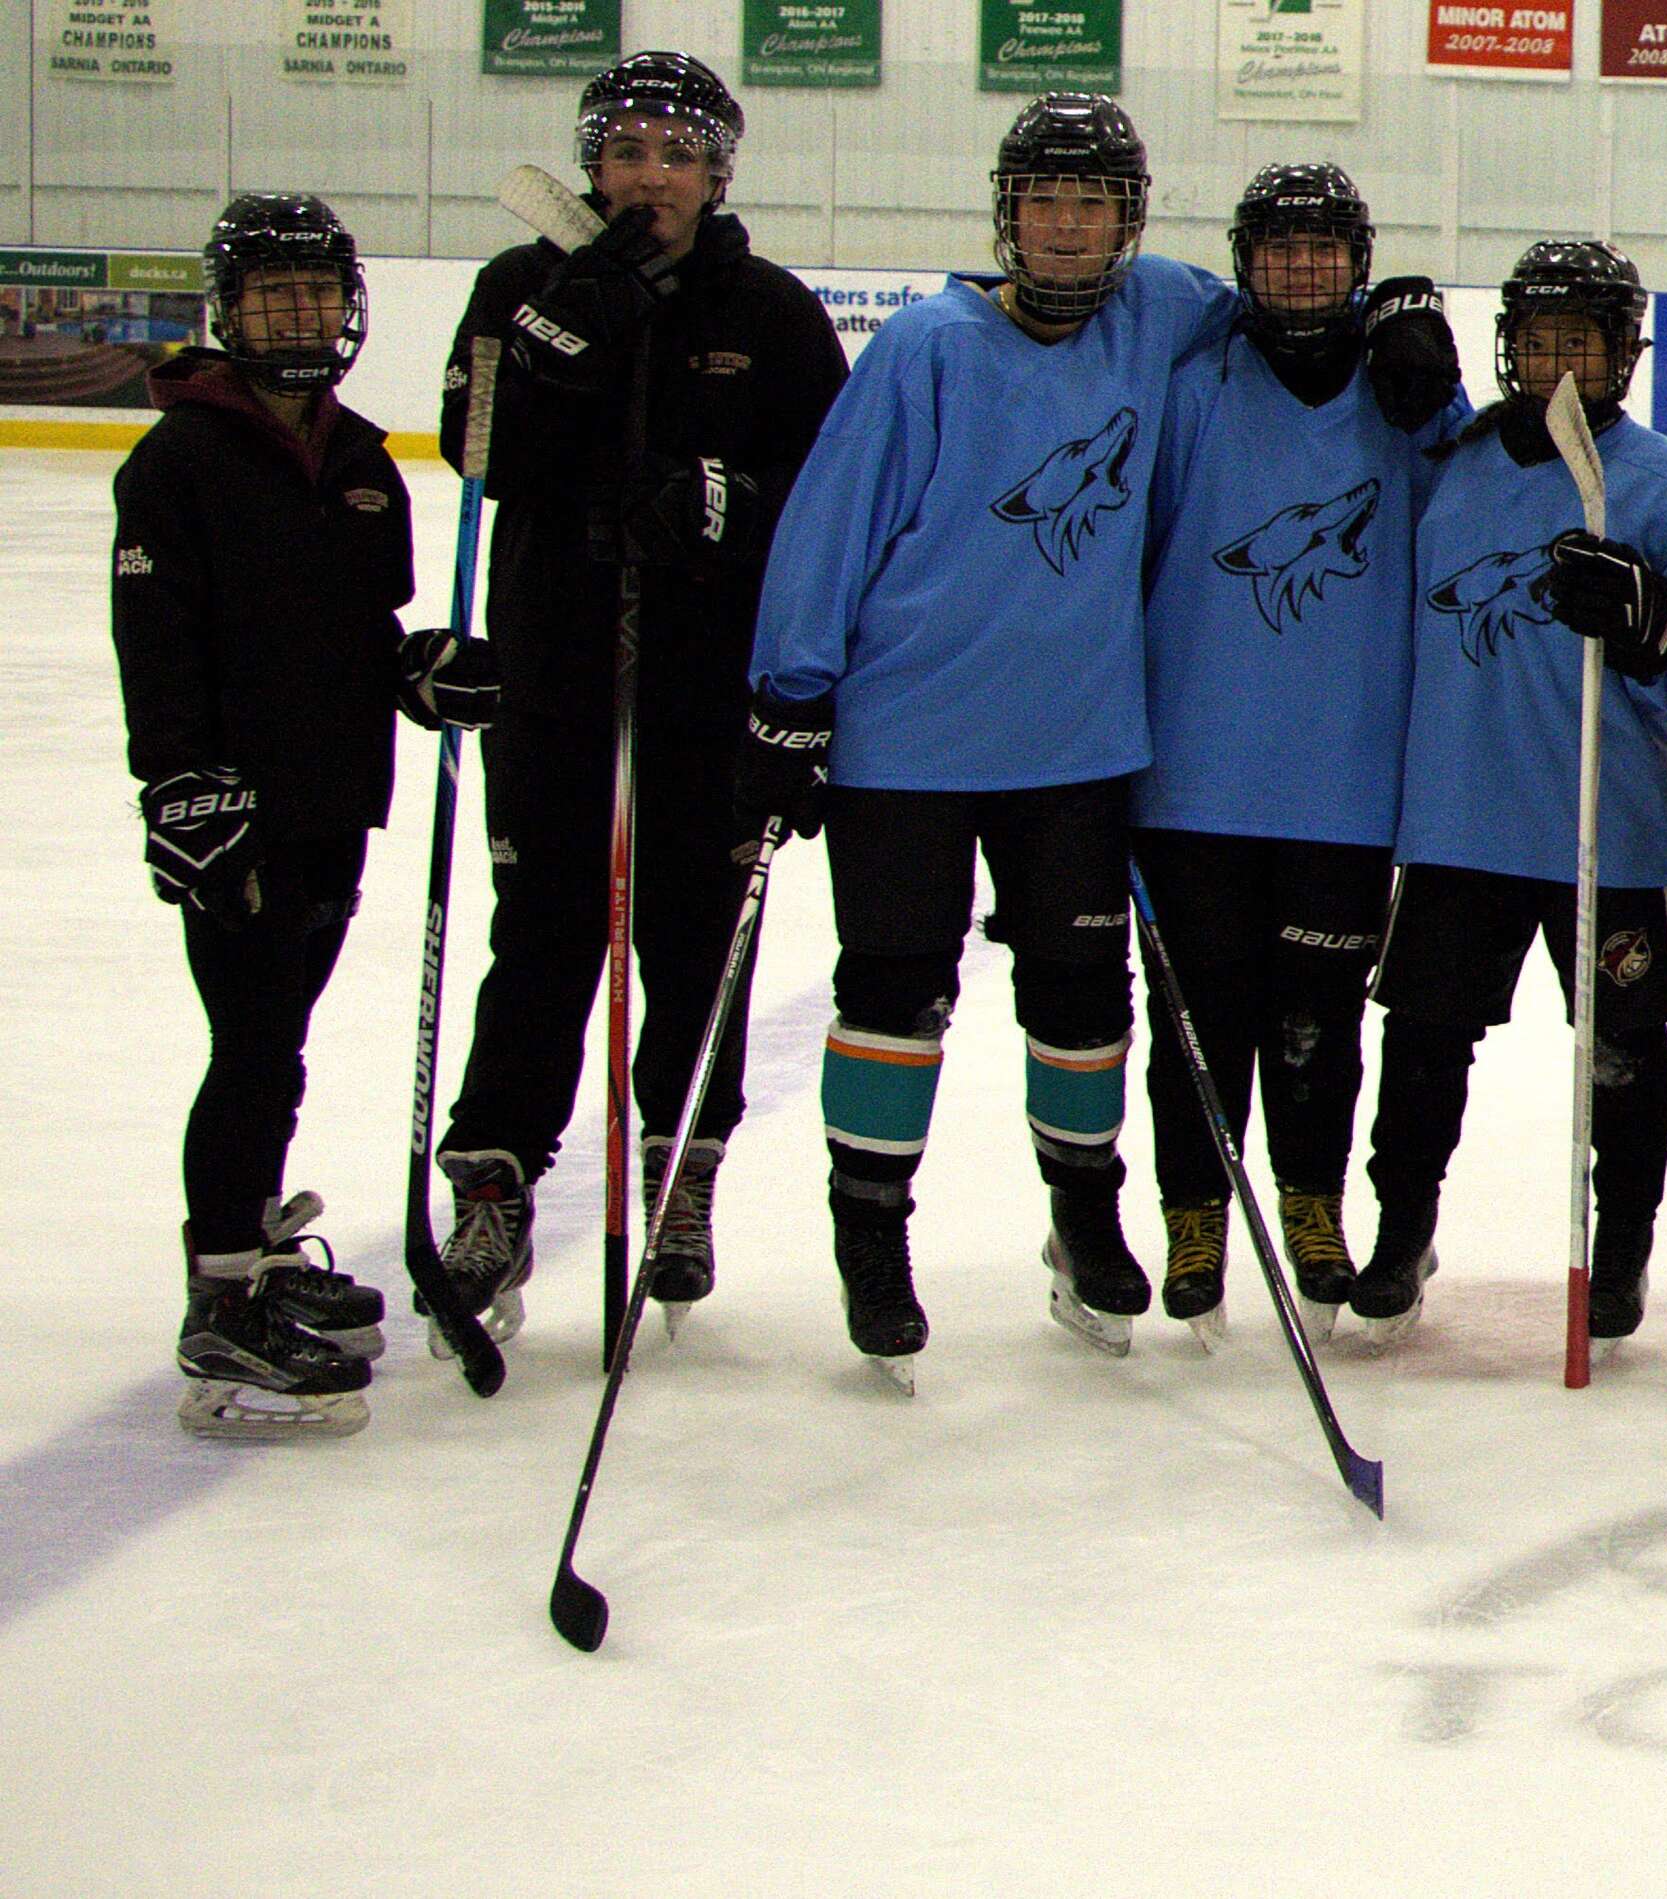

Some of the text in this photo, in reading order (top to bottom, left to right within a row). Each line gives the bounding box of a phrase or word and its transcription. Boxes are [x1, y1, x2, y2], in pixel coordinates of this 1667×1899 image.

[69, 12, 152, 27] MIDGET AA
[306, 13, 380, 27] MIDGET A
[1438, 6, 1567, 31] MINOR ATOM
[62, 30, 156, 50] CHAMPIONS
[296, 31, 393, 51] CHAMPIONS
[502, 28, 603, 51] Champions
[761, 31, 863, 57] Champions
[998, 37, 1102, 62] Champions
[1445, 33, 1554, 54] 2007-2008
[50, 56, 172, 75] SARNIA ONTARIO
[284, 57, 407, 76] SARNIA ONTARIO
[1236, 59, 1341, 84] Champions
[631, 78, 680, 91] CCM
[1276, 194, 1325, 207] CCM
[280, 231, 325, 243] CCM
[1523, 284, 1571, 297] CCM
[280, 367, 330, 381] CCM
[696, 456, 730, 543] UER
[611, 876, 629, 1005] HYPERLITE
[1279, 923, 1380, 952] BAUER
[411, 899, 446, 1160] SHERWOOD
